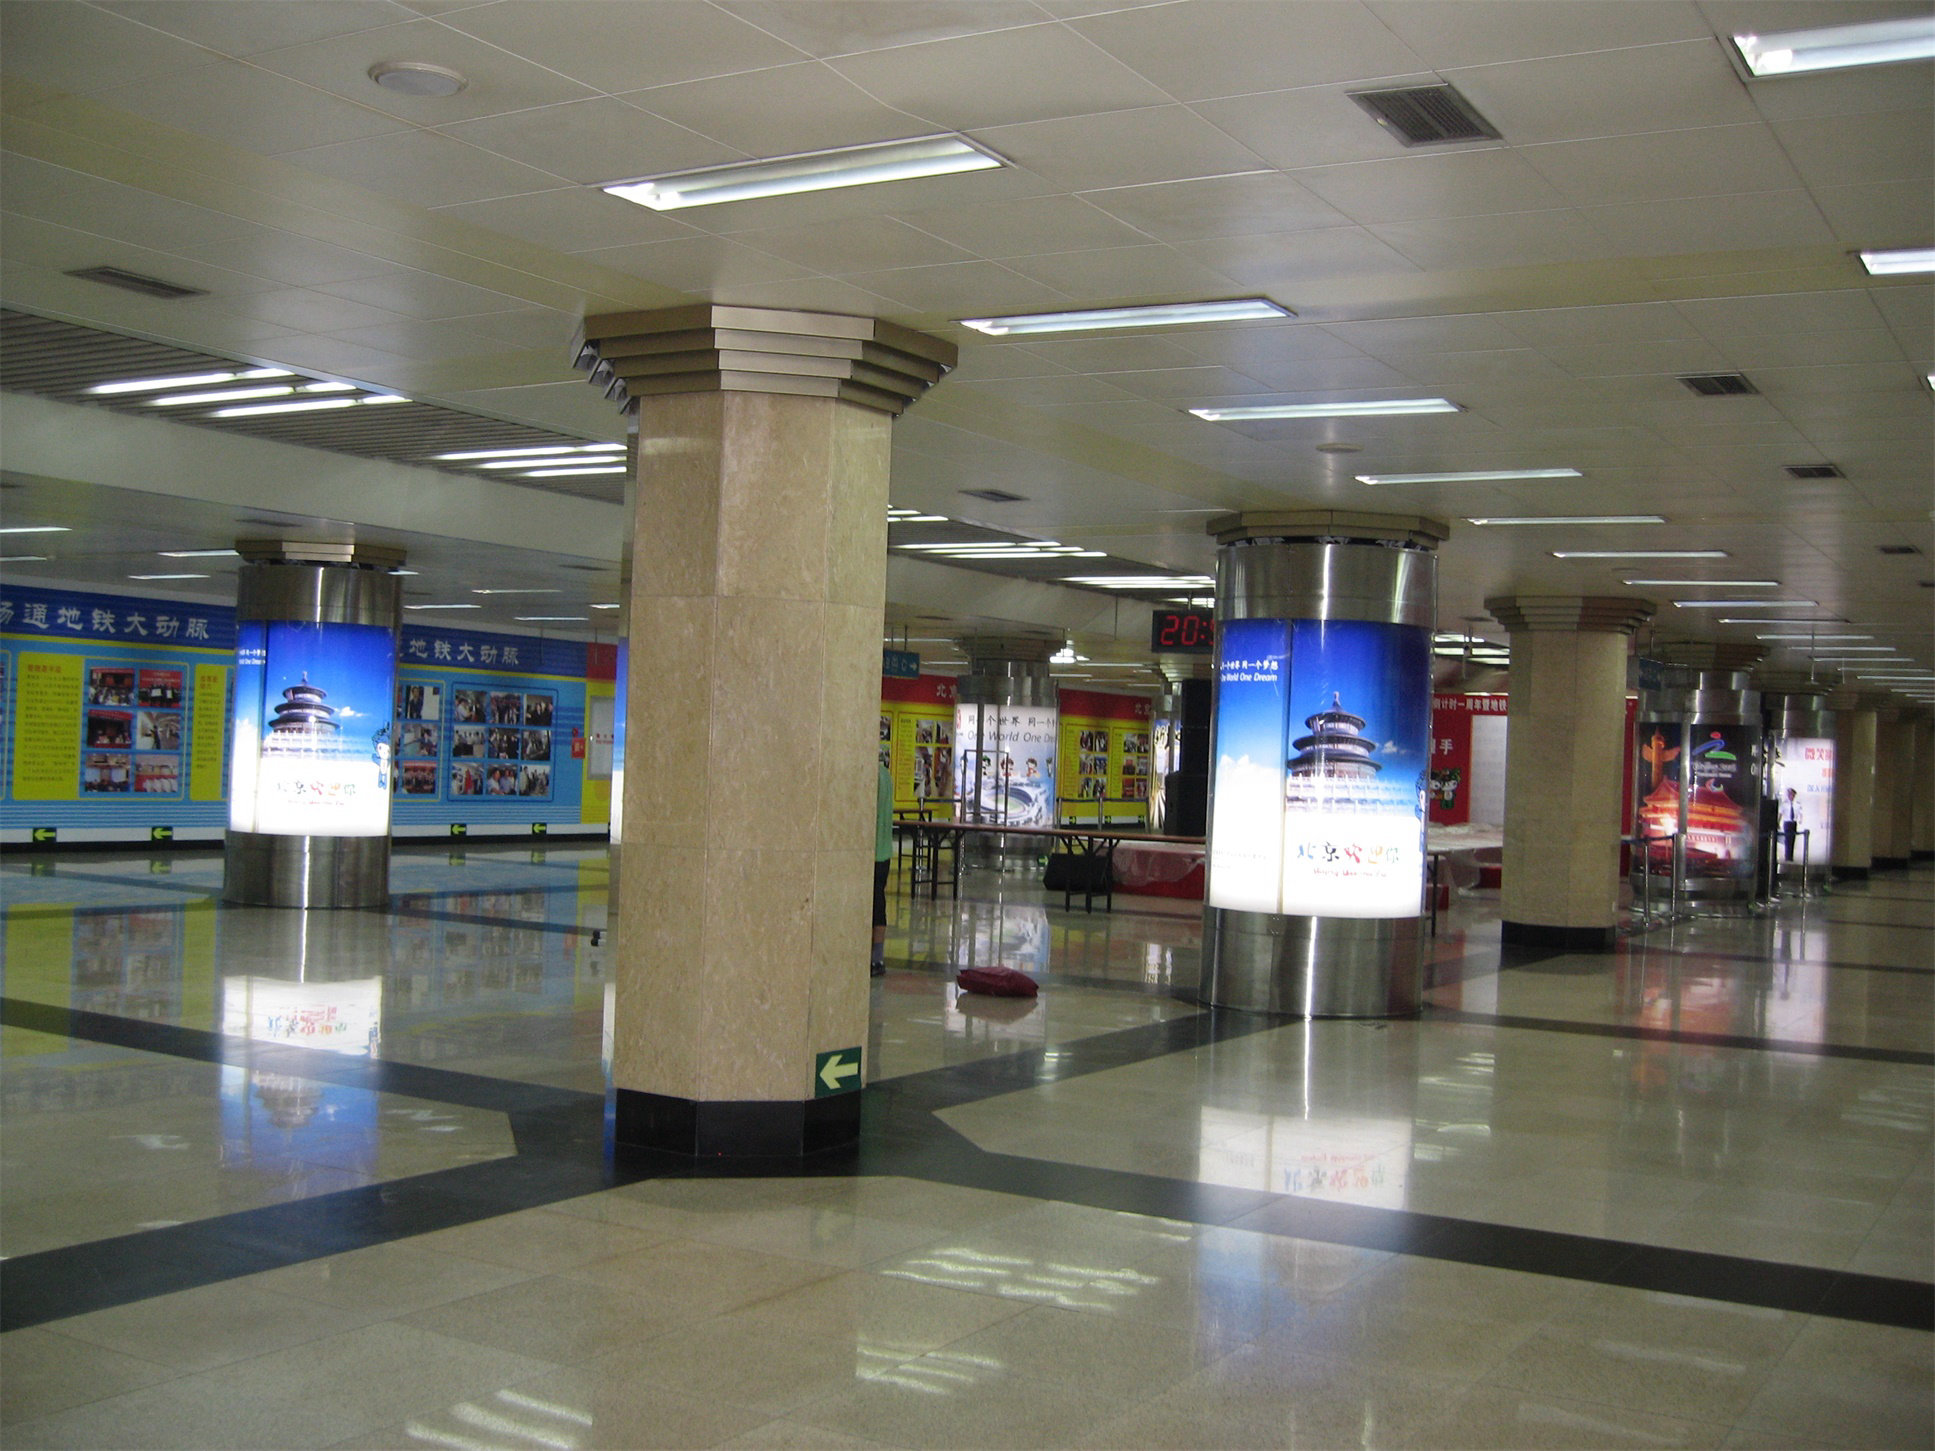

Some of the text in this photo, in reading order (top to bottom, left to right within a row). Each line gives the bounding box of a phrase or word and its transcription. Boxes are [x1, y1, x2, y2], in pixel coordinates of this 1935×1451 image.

[1160, 615, 1214, 646] 20:
[400, 638, 519, 665] 地铁大动脉
[1241, 660, 1278, 671] 同一个梦想
[1240, 672, 1252, 681] One
[1253, 672, 1278, 682] Dream
[968, 714, 1021, 727] 同个世界
[988, 731, 1019, 742] World
[1023, 733, 1041, 743] One
